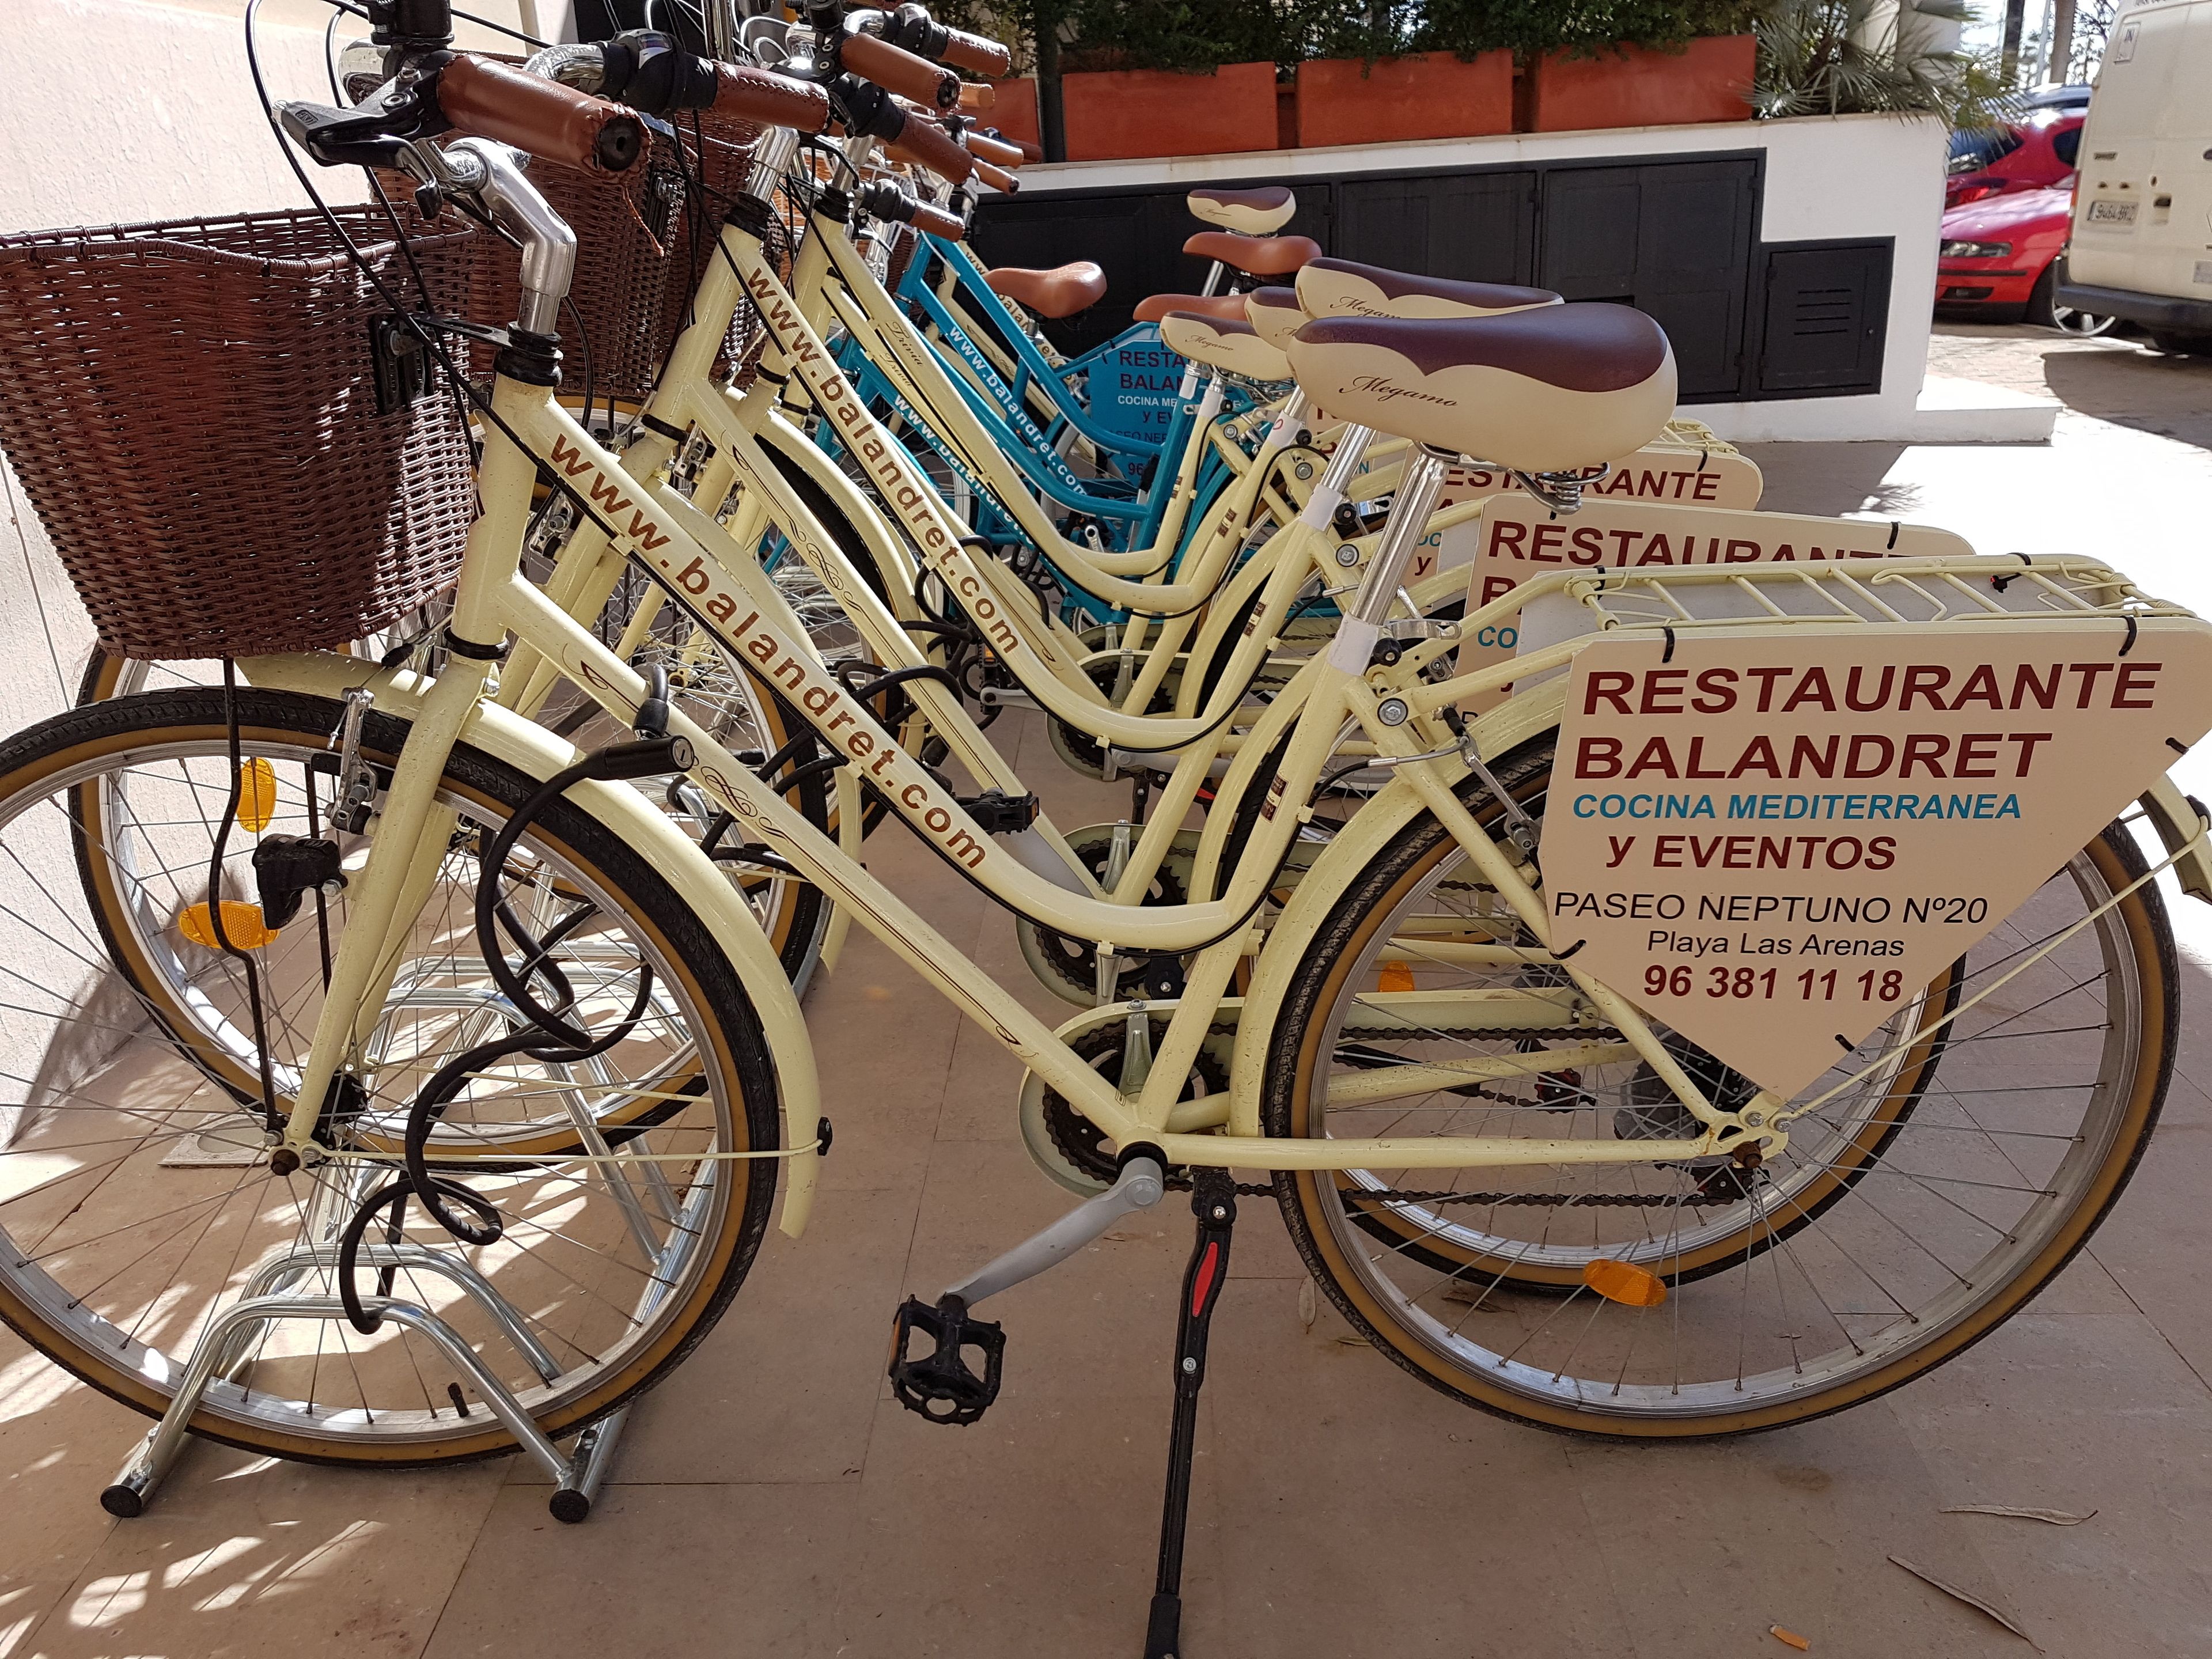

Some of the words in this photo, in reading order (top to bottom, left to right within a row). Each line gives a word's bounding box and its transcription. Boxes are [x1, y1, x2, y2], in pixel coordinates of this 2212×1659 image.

[1185, 334, 1234, 351] Megamo
[1118, 396, 1159, 406] COCINA
[1339, 376, 1458, 407] Megamo
[748, 267, 1018, 654] www.balandret.com
[550, 433, 986, 869] www.balandret.com
[1583, 662, 2163, 715] RESTAURANTE
[1574, 733, 2053, 779] BALANDRET
[1573, 794, 1716, 819] COCINA
[1727, 794, 2021, 820] MEDITERRANEA
[1605, 836, 1637, 868] y
[1653, 836, 1897, 870] EVENTOS
[1554, 892, 1685, 920] PASEO
[1698, 895, 1892, 923] NEPTUNO
[1903, 897, 1989, 924] Nº20
[1647, 930, 1729, 959] Playa
[1740, 933, 1792, 955] Las
[1800, 934, 1906, 957] Arenas
[1643, 965, 1693, 997] 96
[1705, 967, 1778, 1000] 381
[1797, 969, 1836, 1001] 11
[1856, 969, 1904, 1002] 18
